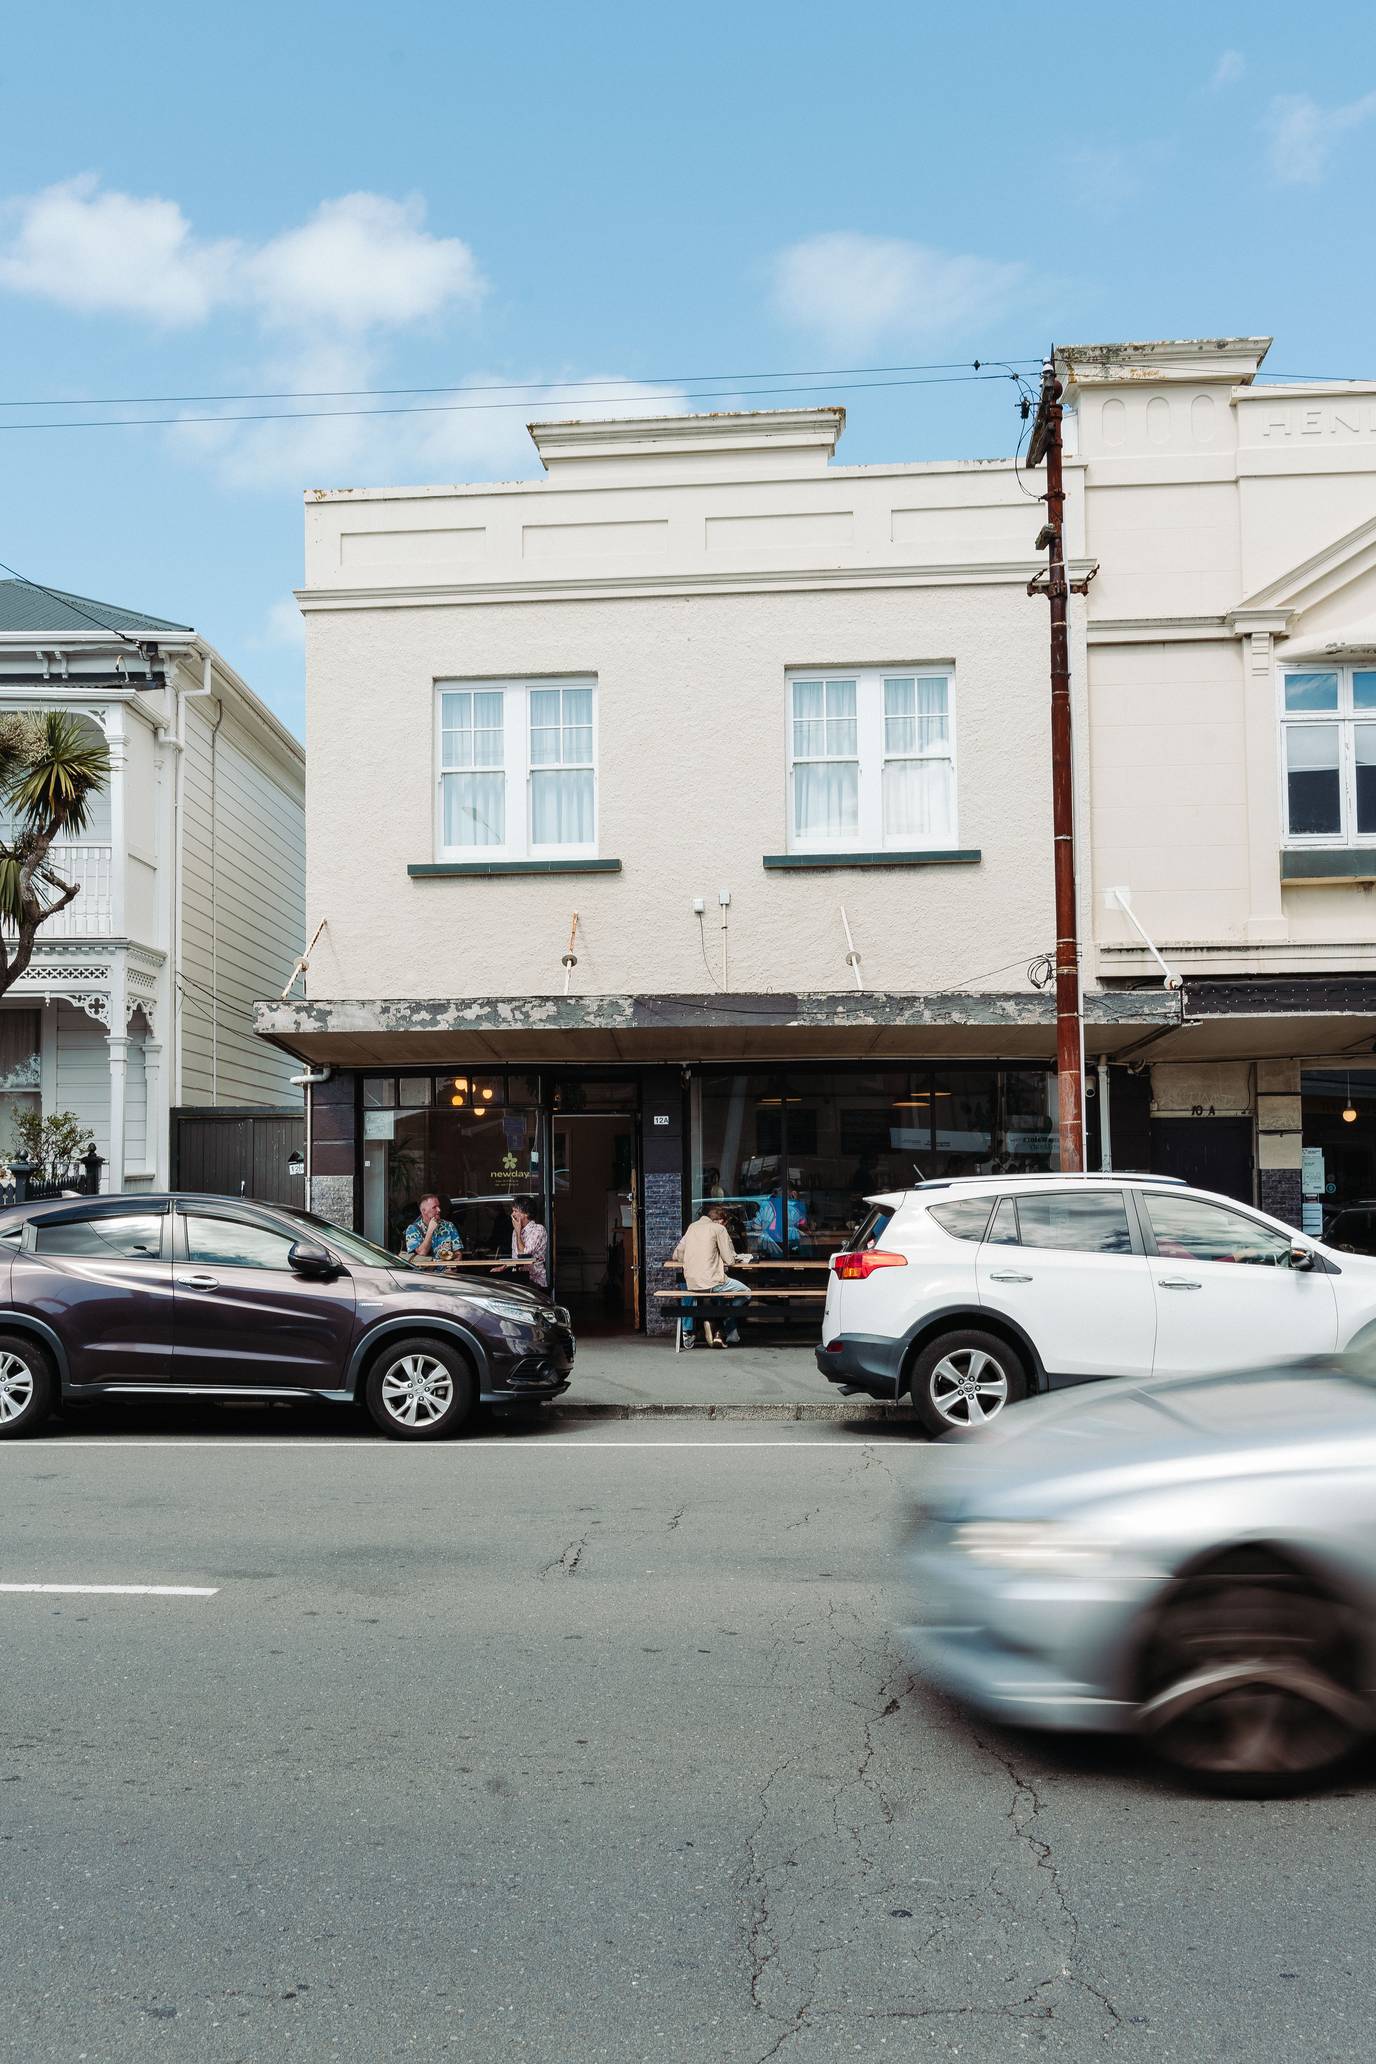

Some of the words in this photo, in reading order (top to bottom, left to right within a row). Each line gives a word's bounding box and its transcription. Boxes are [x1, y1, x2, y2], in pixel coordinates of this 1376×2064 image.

[1192, 1104, 1203, 1116] 10
[1208, 1104, 1215, 1116] A
[655, 1116, 669, 1125] 12A
[490, 1170, 529, 1179] newday
